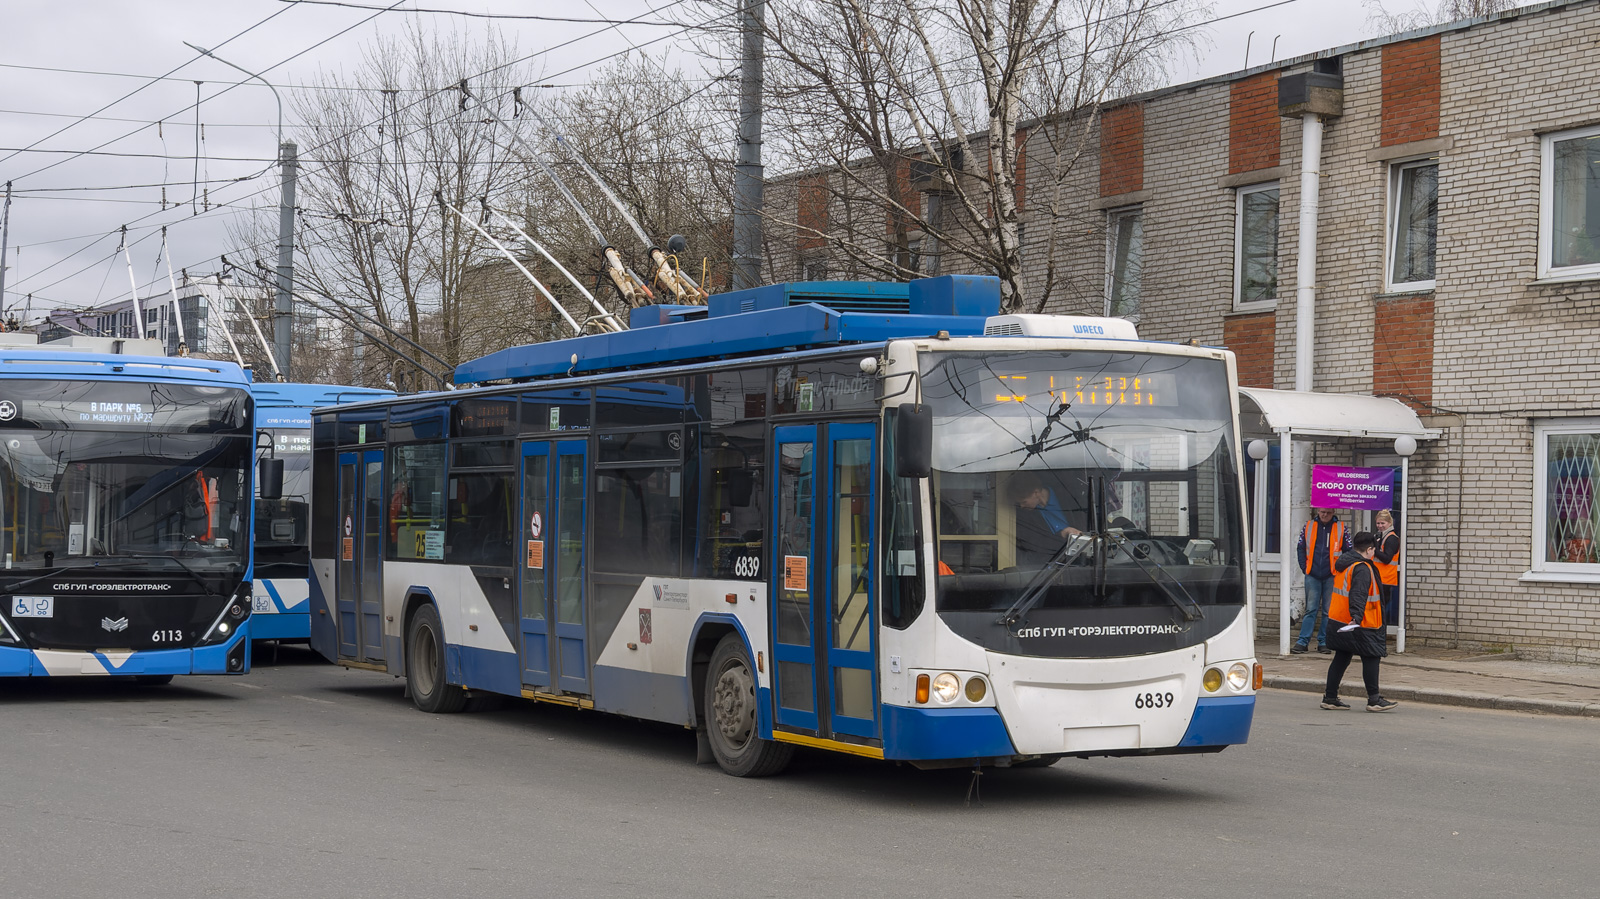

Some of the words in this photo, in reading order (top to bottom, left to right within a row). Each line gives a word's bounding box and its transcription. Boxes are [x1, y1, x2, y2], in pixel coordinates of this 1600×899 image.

[1073, 324, 1104, 335] WAECO
[91, 402, 97, 412] В
[100, 402, 123, 412] ПАРК
[126, 403, 141, 413] №6
[80, 413, 90, 421] по
[92, 413, 131, 423] маршруту
[133, 413, 153, 422] №23
[280, 435, 288, 444] В
[1316, 481, 1345, 490] СКОРО
[1346, 483, 1390, 492] ОТКРЫТИЕ
[416, 533, 425, 557] 25
[735, 556, 760, 577] 6839
[53, 583, 70, 591] СПб
[70, 583, 88, 591] ГУП
[152, 630, 183, 642] 6113
[1018, 626, 1041, 638] СПб
[1043, 627, 1066, 637] ГУП
[1135, 692, 1174, 709] 6839
